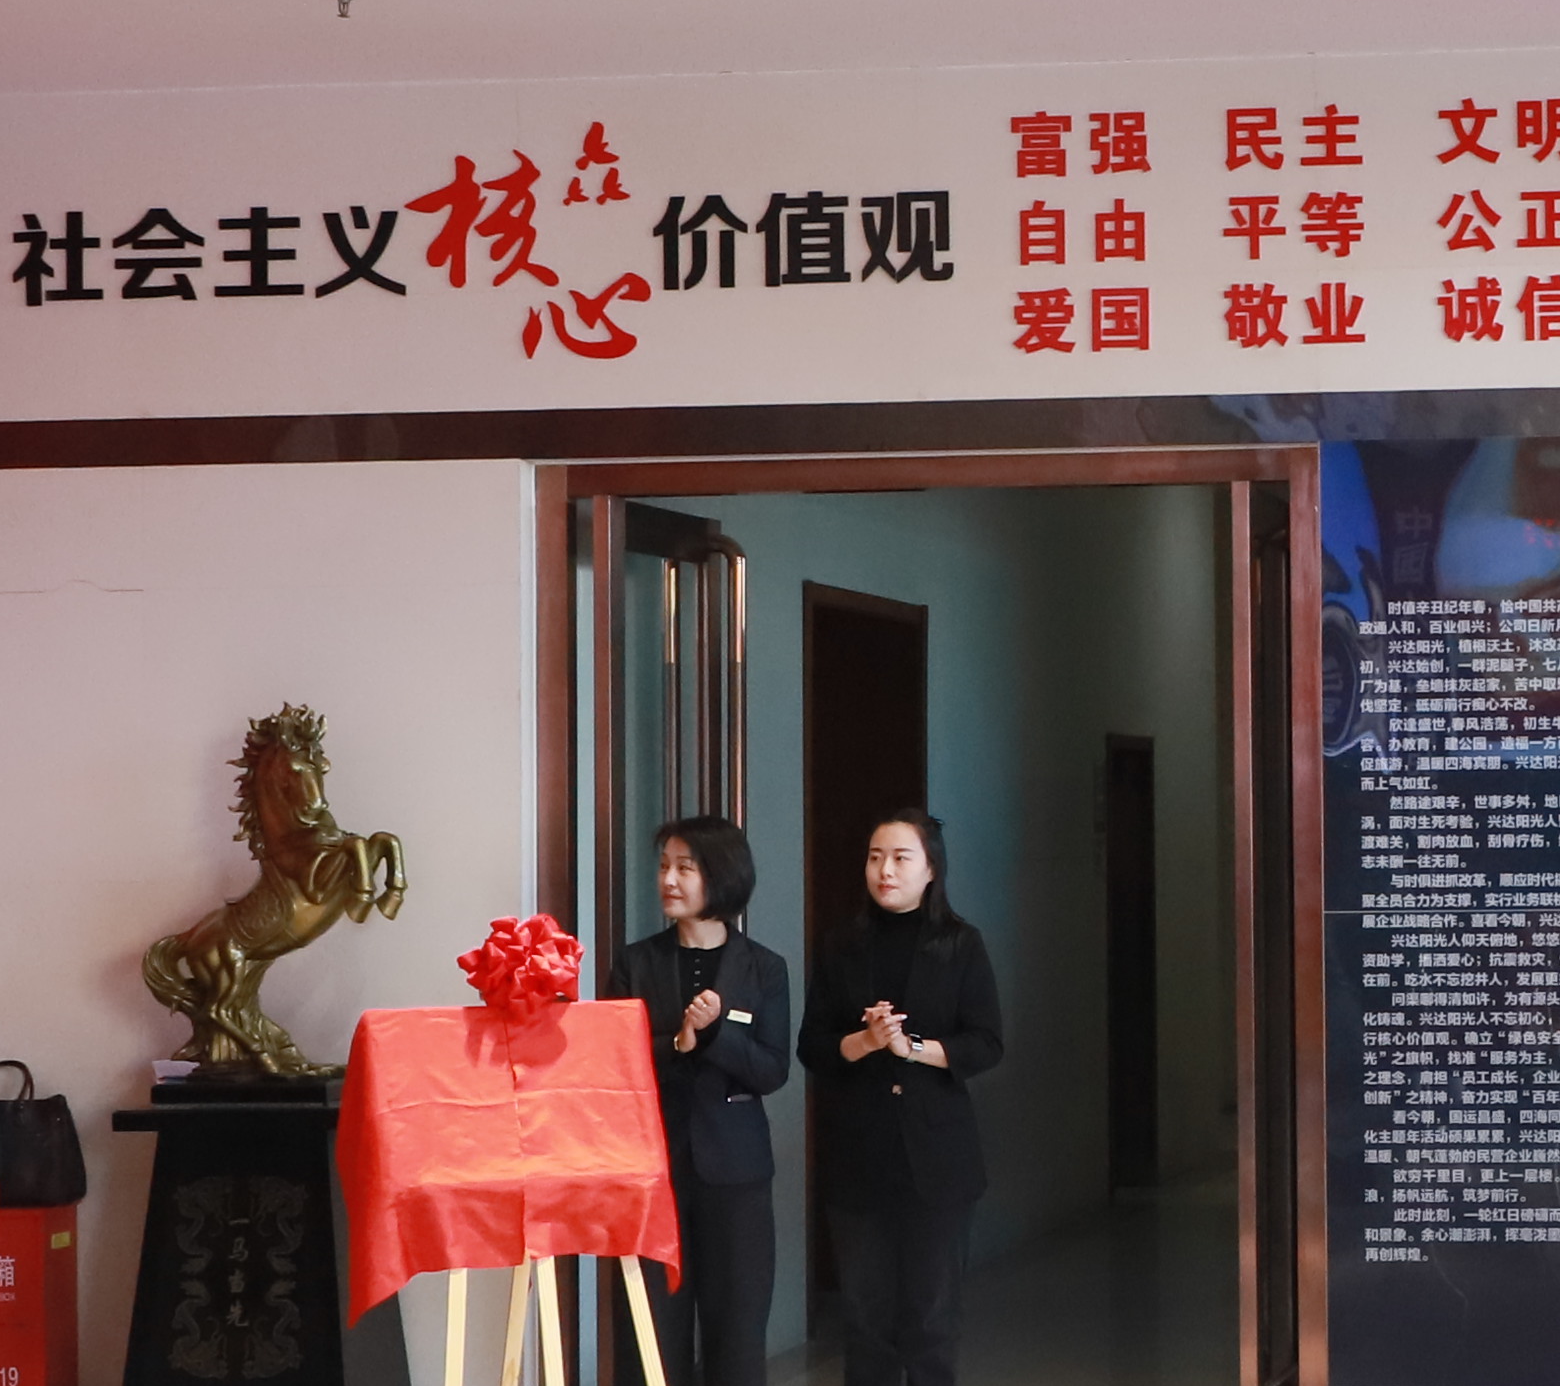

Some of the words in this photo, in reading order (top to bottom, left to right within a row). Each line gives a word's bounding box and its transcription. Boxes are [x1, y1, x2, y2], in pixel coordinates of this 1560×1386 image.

[1010, 111, 1151, 179] 富强
[1224, 104, 1363, 173] 民主
[1016, 198, 1148, 267] 自由
[1224, 192, 1365, 260] 平等
[1012, 287, 1151, 356] 爱国
[1224, 281, 1366, 349] 敬业
[1360, 775, 1439, 792] 而上气如虹。
